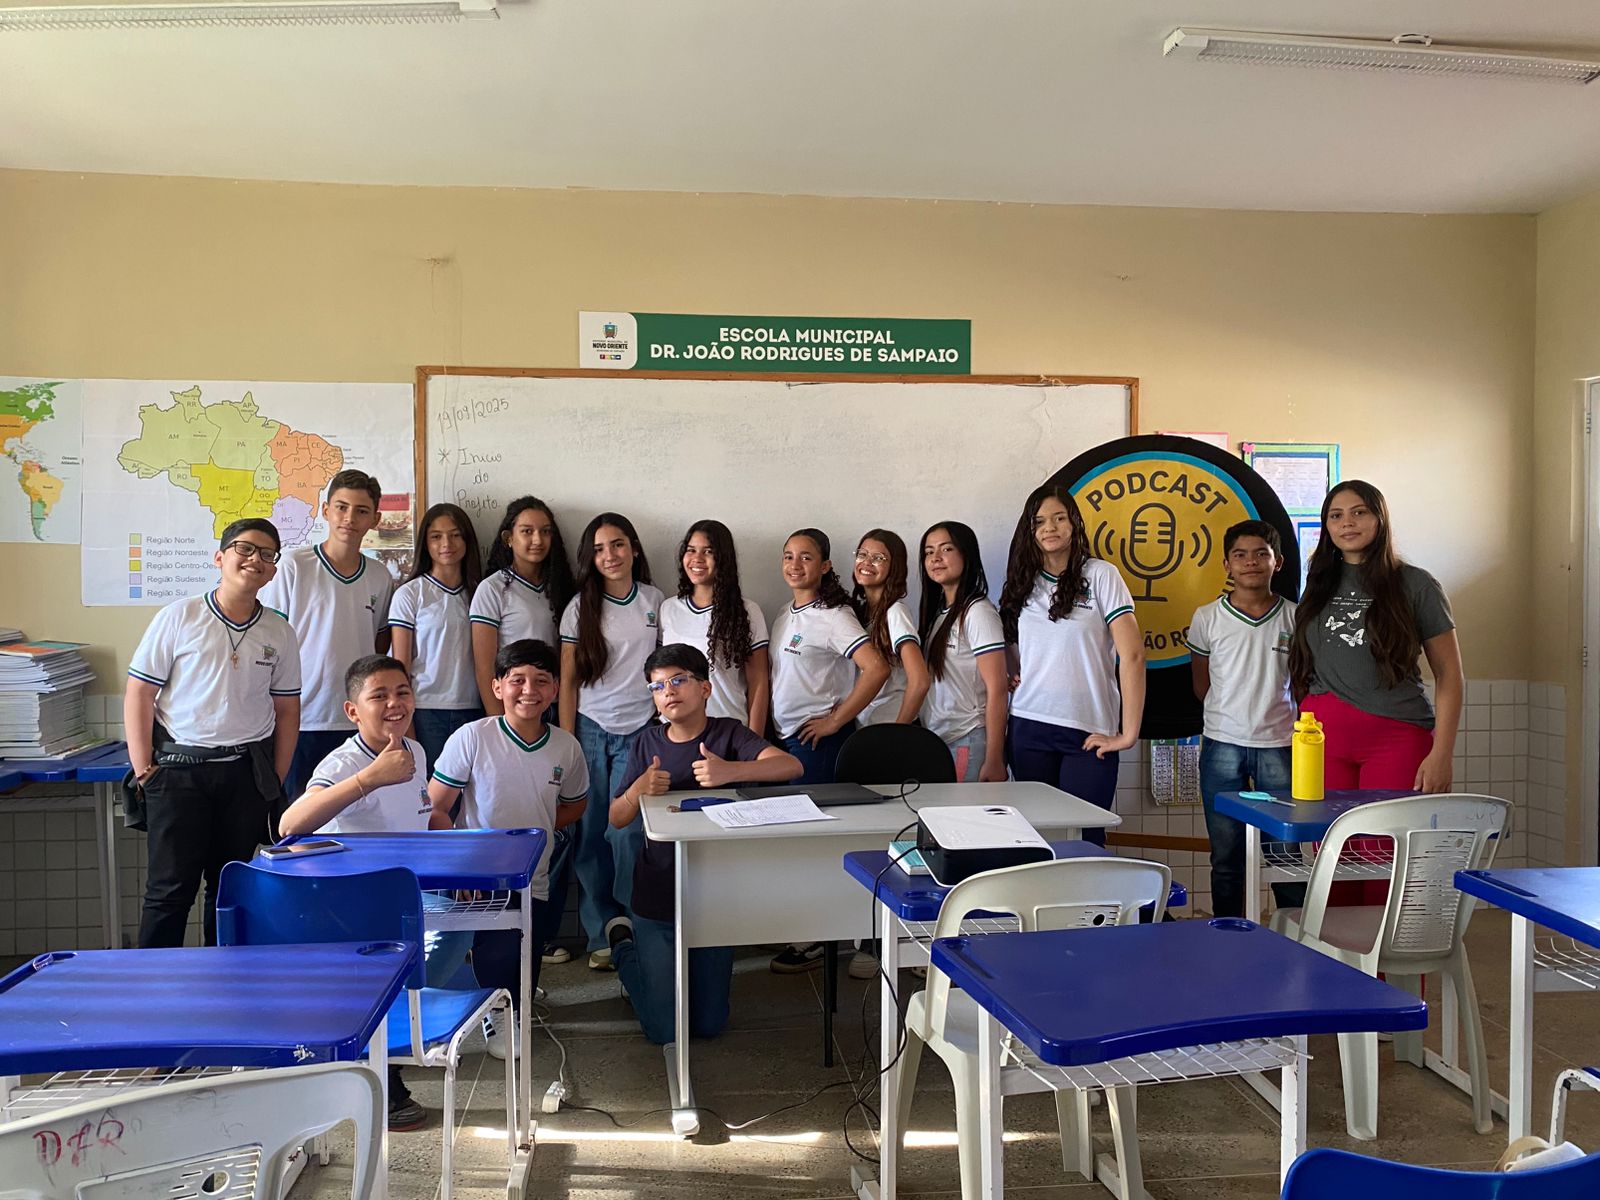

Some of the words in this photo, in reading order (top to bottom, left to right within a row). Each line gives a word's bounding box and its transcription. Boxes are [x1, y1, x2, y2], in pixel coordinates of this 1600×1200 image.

[719, 327, 791, 343] ESCOLA
[795, 328, 895, 345] MUNICIPAL
[650, 343, 680, 359] DR.
[682, 341, 735, 360] JOÃO
[740, 346, 845, 362] RODRIGUES
[850, 347, 873, 362] DE
[877, 348, 959, 363] SAMPAIO
[473, 469, 489, 484] do
[1085, 470, 1229, 514] PODCAST
[146, 536, 173, 544] Região
[174, 536, 196, 544] Norte
[146, 548, 173, 557] Região
[146, 561, 173, 570] Região
[147, 575, 173, 584] Região
[147, 589, 173, 597] Região
[1144, 630, 1167, 650] ÃO
